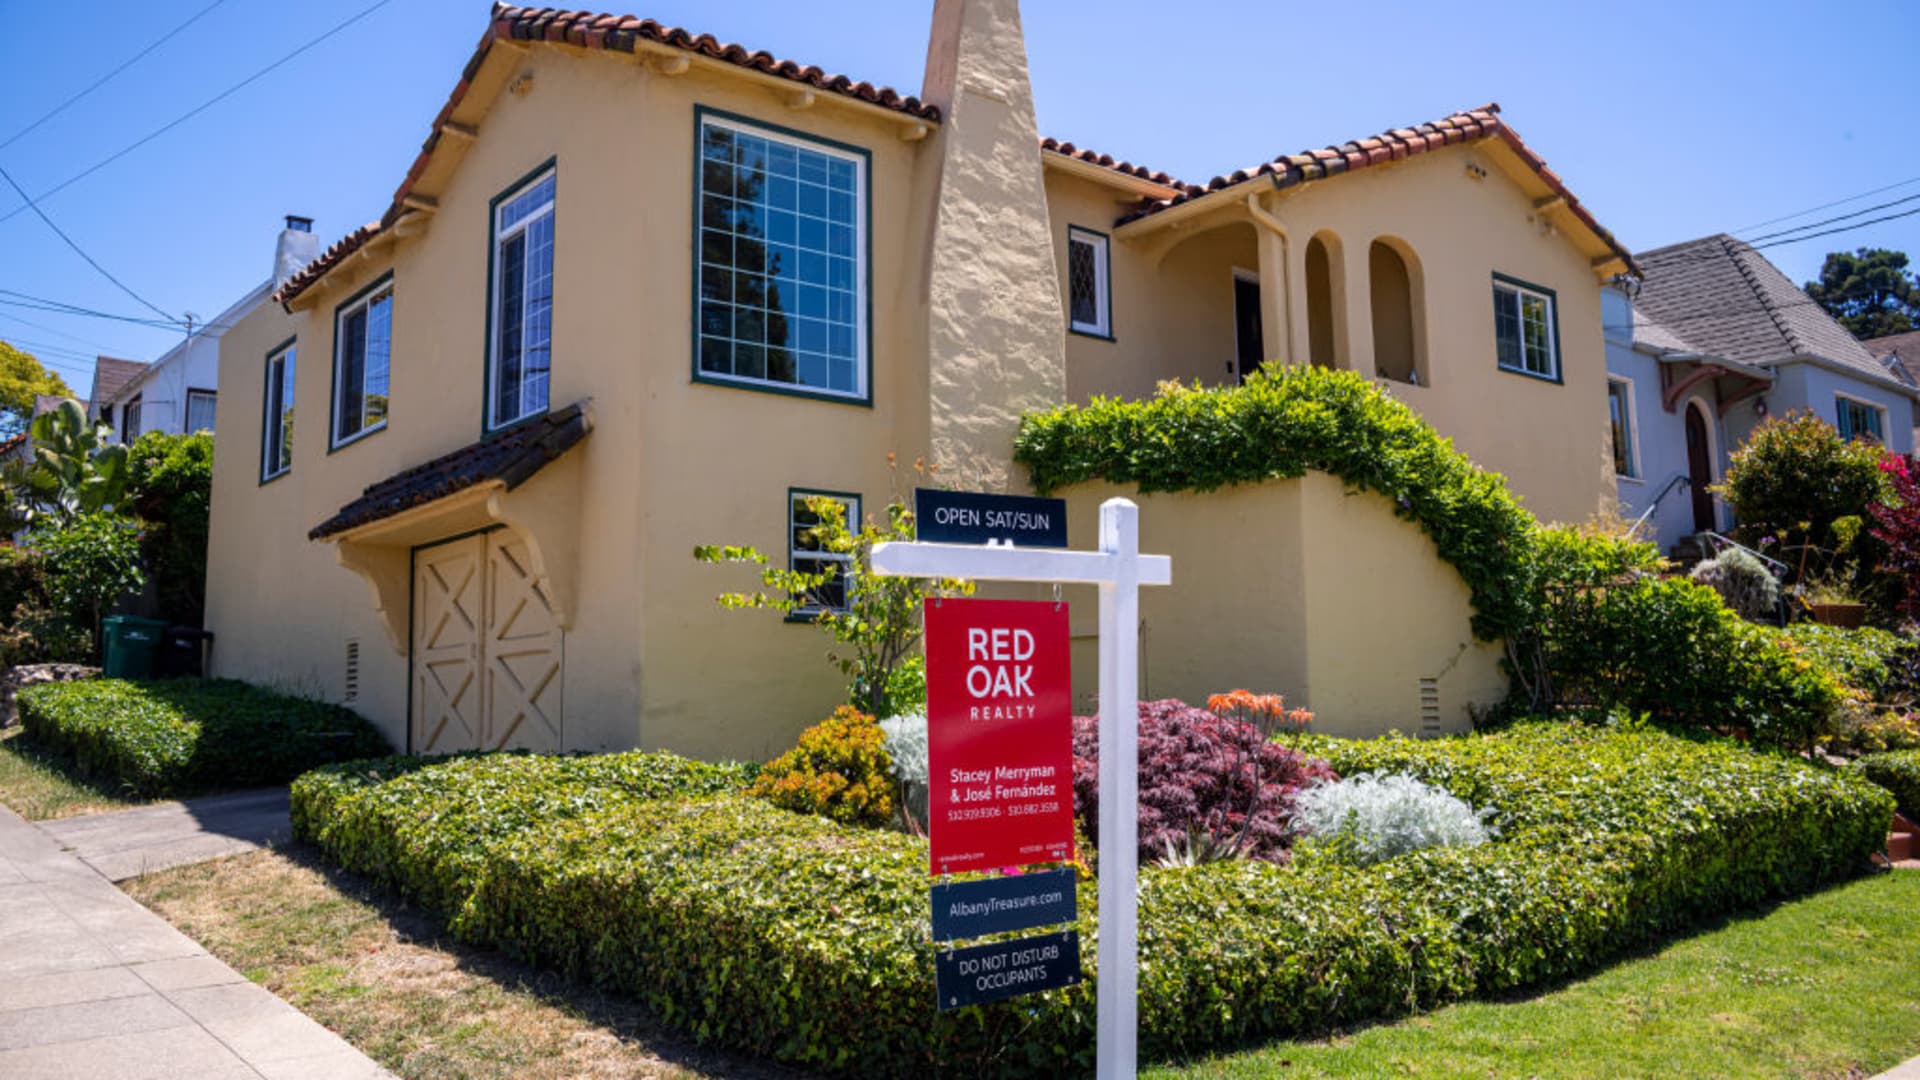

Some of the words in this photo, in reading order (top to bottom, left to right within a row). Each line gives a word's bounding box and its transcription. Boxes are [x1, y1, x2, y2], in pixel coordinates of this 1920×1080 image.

[935, 507, 980, 526] OPEN
[985, 511, 1050, 530] SAT/SUN
[969, 628, 1035, 661] RED
[966, 665, 1035, 698] OAK
[970, 704, 1036, 720] REALTY
[950, 768, 991, 784] Stacey
[995, 766, 1055, 782] Merryman
[950, 788, 960, 803] &
[963, 786, 992, 802] José
[995, 782, 1056, 799] Fernández
[950, 891, 1062, 916] AlbanyTreasure.com
[959, 960, 979, 975] DO
[981, 954, 1008, 971] NOT
[1011, 945, 1060, 966] DISTURB
[976, 965, 1047, 991] OCCUPANTS
